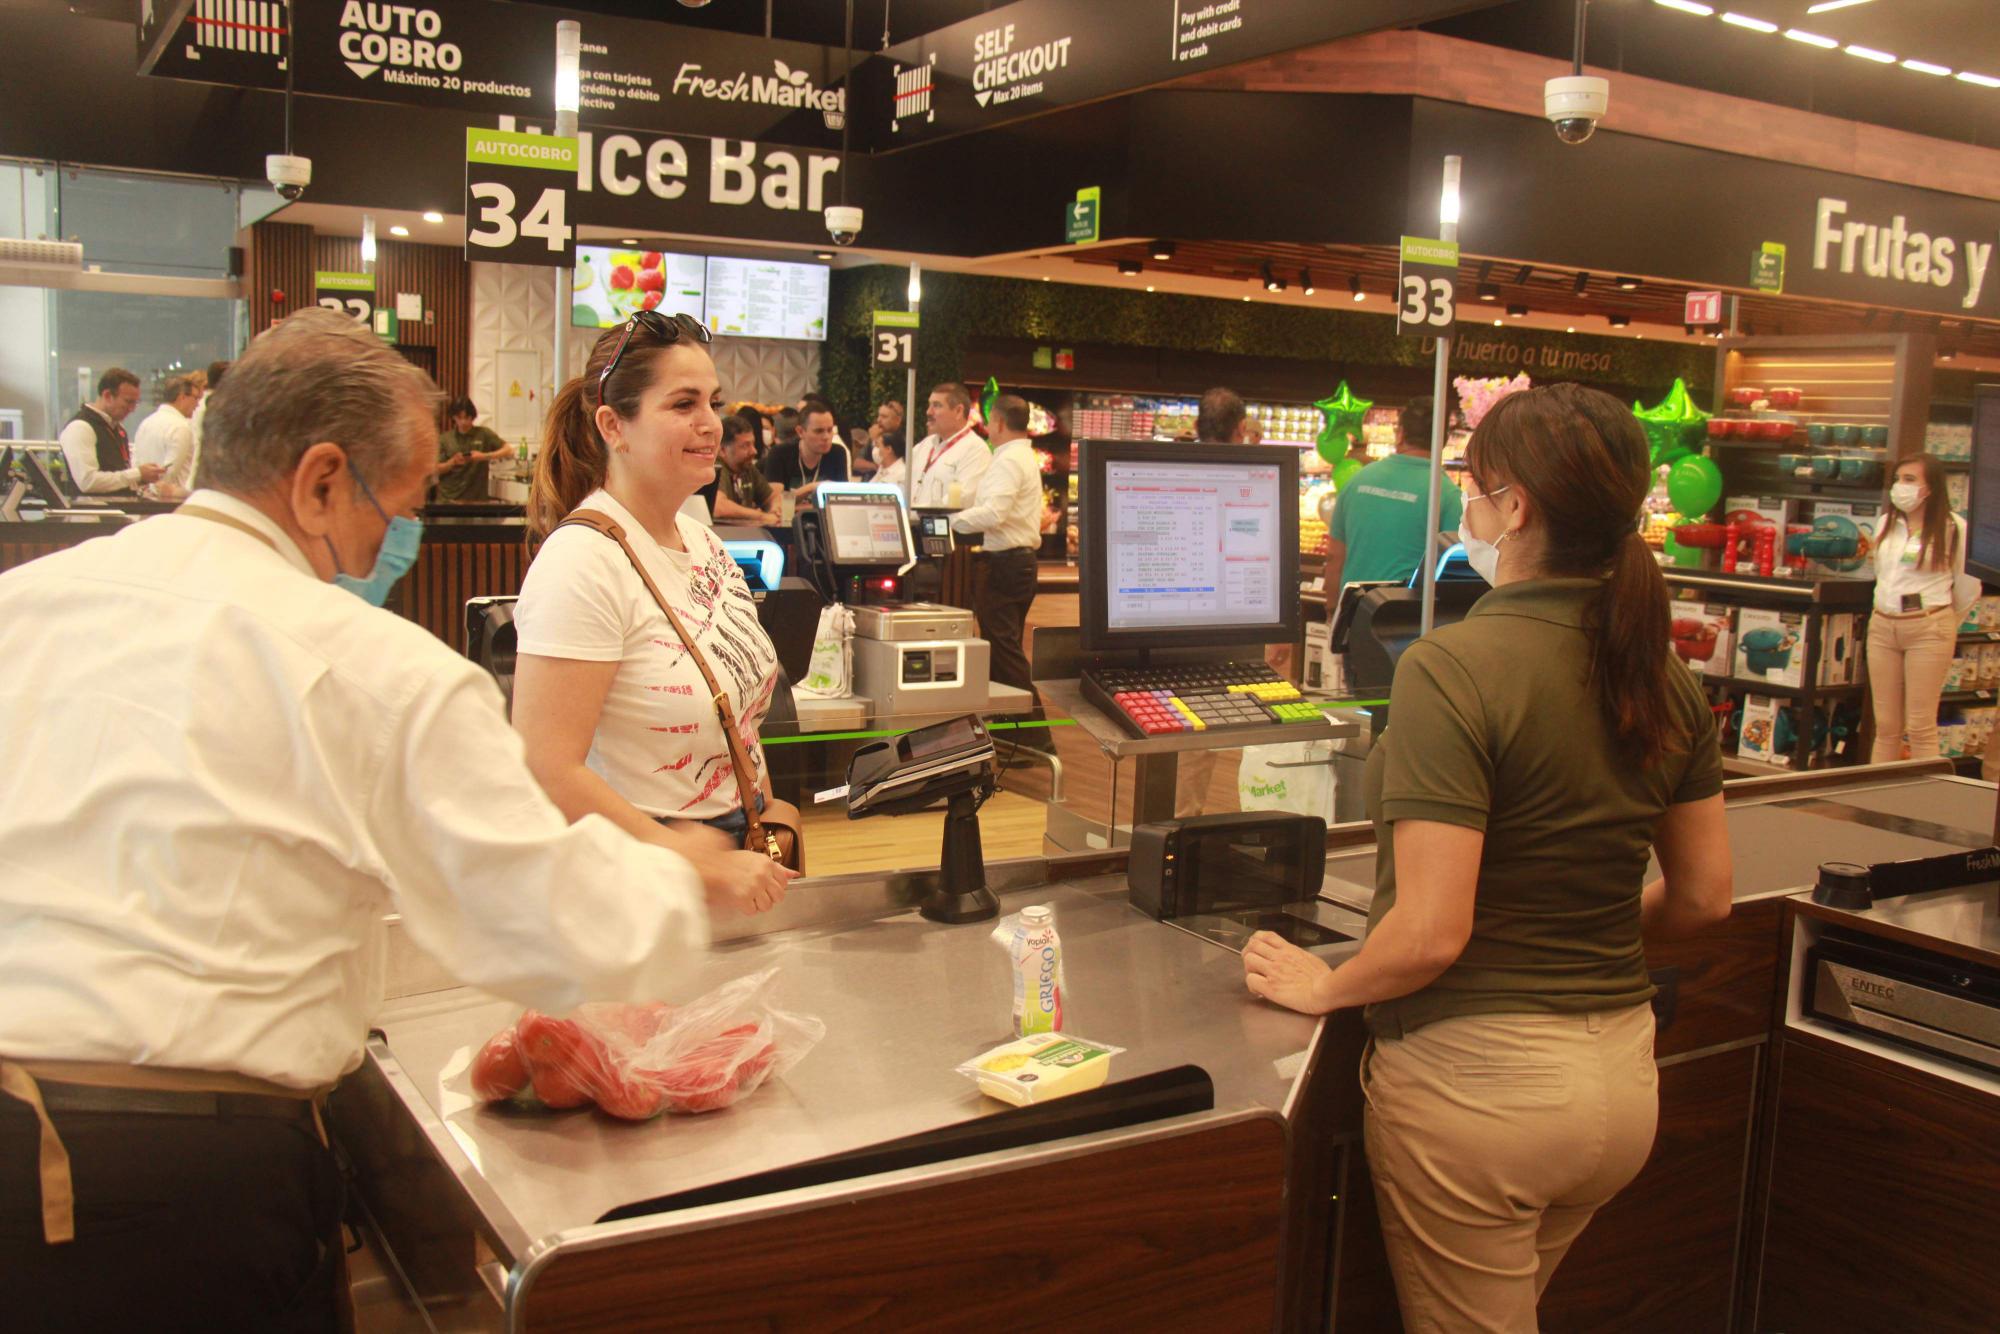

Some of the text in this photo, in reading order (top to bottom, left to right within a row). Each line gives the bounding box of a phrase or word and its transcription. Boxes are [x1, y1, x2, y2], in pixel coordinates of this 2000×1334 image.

[339, 0, 442, 39] AUTO
[1181, 0, 1241, 26] Pay with credit
[974, 23, 1015, 62] SELF
[1180, 15, 1242, 43] and debit cards
[339, 31, 462, 72] COBRO
[973, 36, 1071, 91] CHECKOUT
[1179, 42, 1208, 61] or cash
[383, 68, 532, 98] Máximo 20 productos
[592, 71, 612, 81] con
[612, 73, 653, 87] tarjetas
[993, 81, 1044, 105] Max 20 items
[579, 96, 616, 111] fectivo
[618, 89, 626, 98] o
[626, 88, 661, 102] débito
[474, 138, 573, 162] AUTOCOBRO
[709, 137, 841, 213] Bar
[467, 182, 572, 252] 34
[1405, 244, 1456, 261] AUTOCOBRO
[1813, 197, 1993, 308] Frutas y
[1400, 275, 1453, 327] 33
[877, 332, 912, 363] 31
[1456, 334, 1519, 364] huerto
[1523, 347, 1536, 365] a
[1540, 345, 1560, 367] tu
[1562, 351, 1612, 371] mesa
[1039, 946, 1056, 1013] GRIEGO
[1851, 977, 1895, 1001] ENTEC
